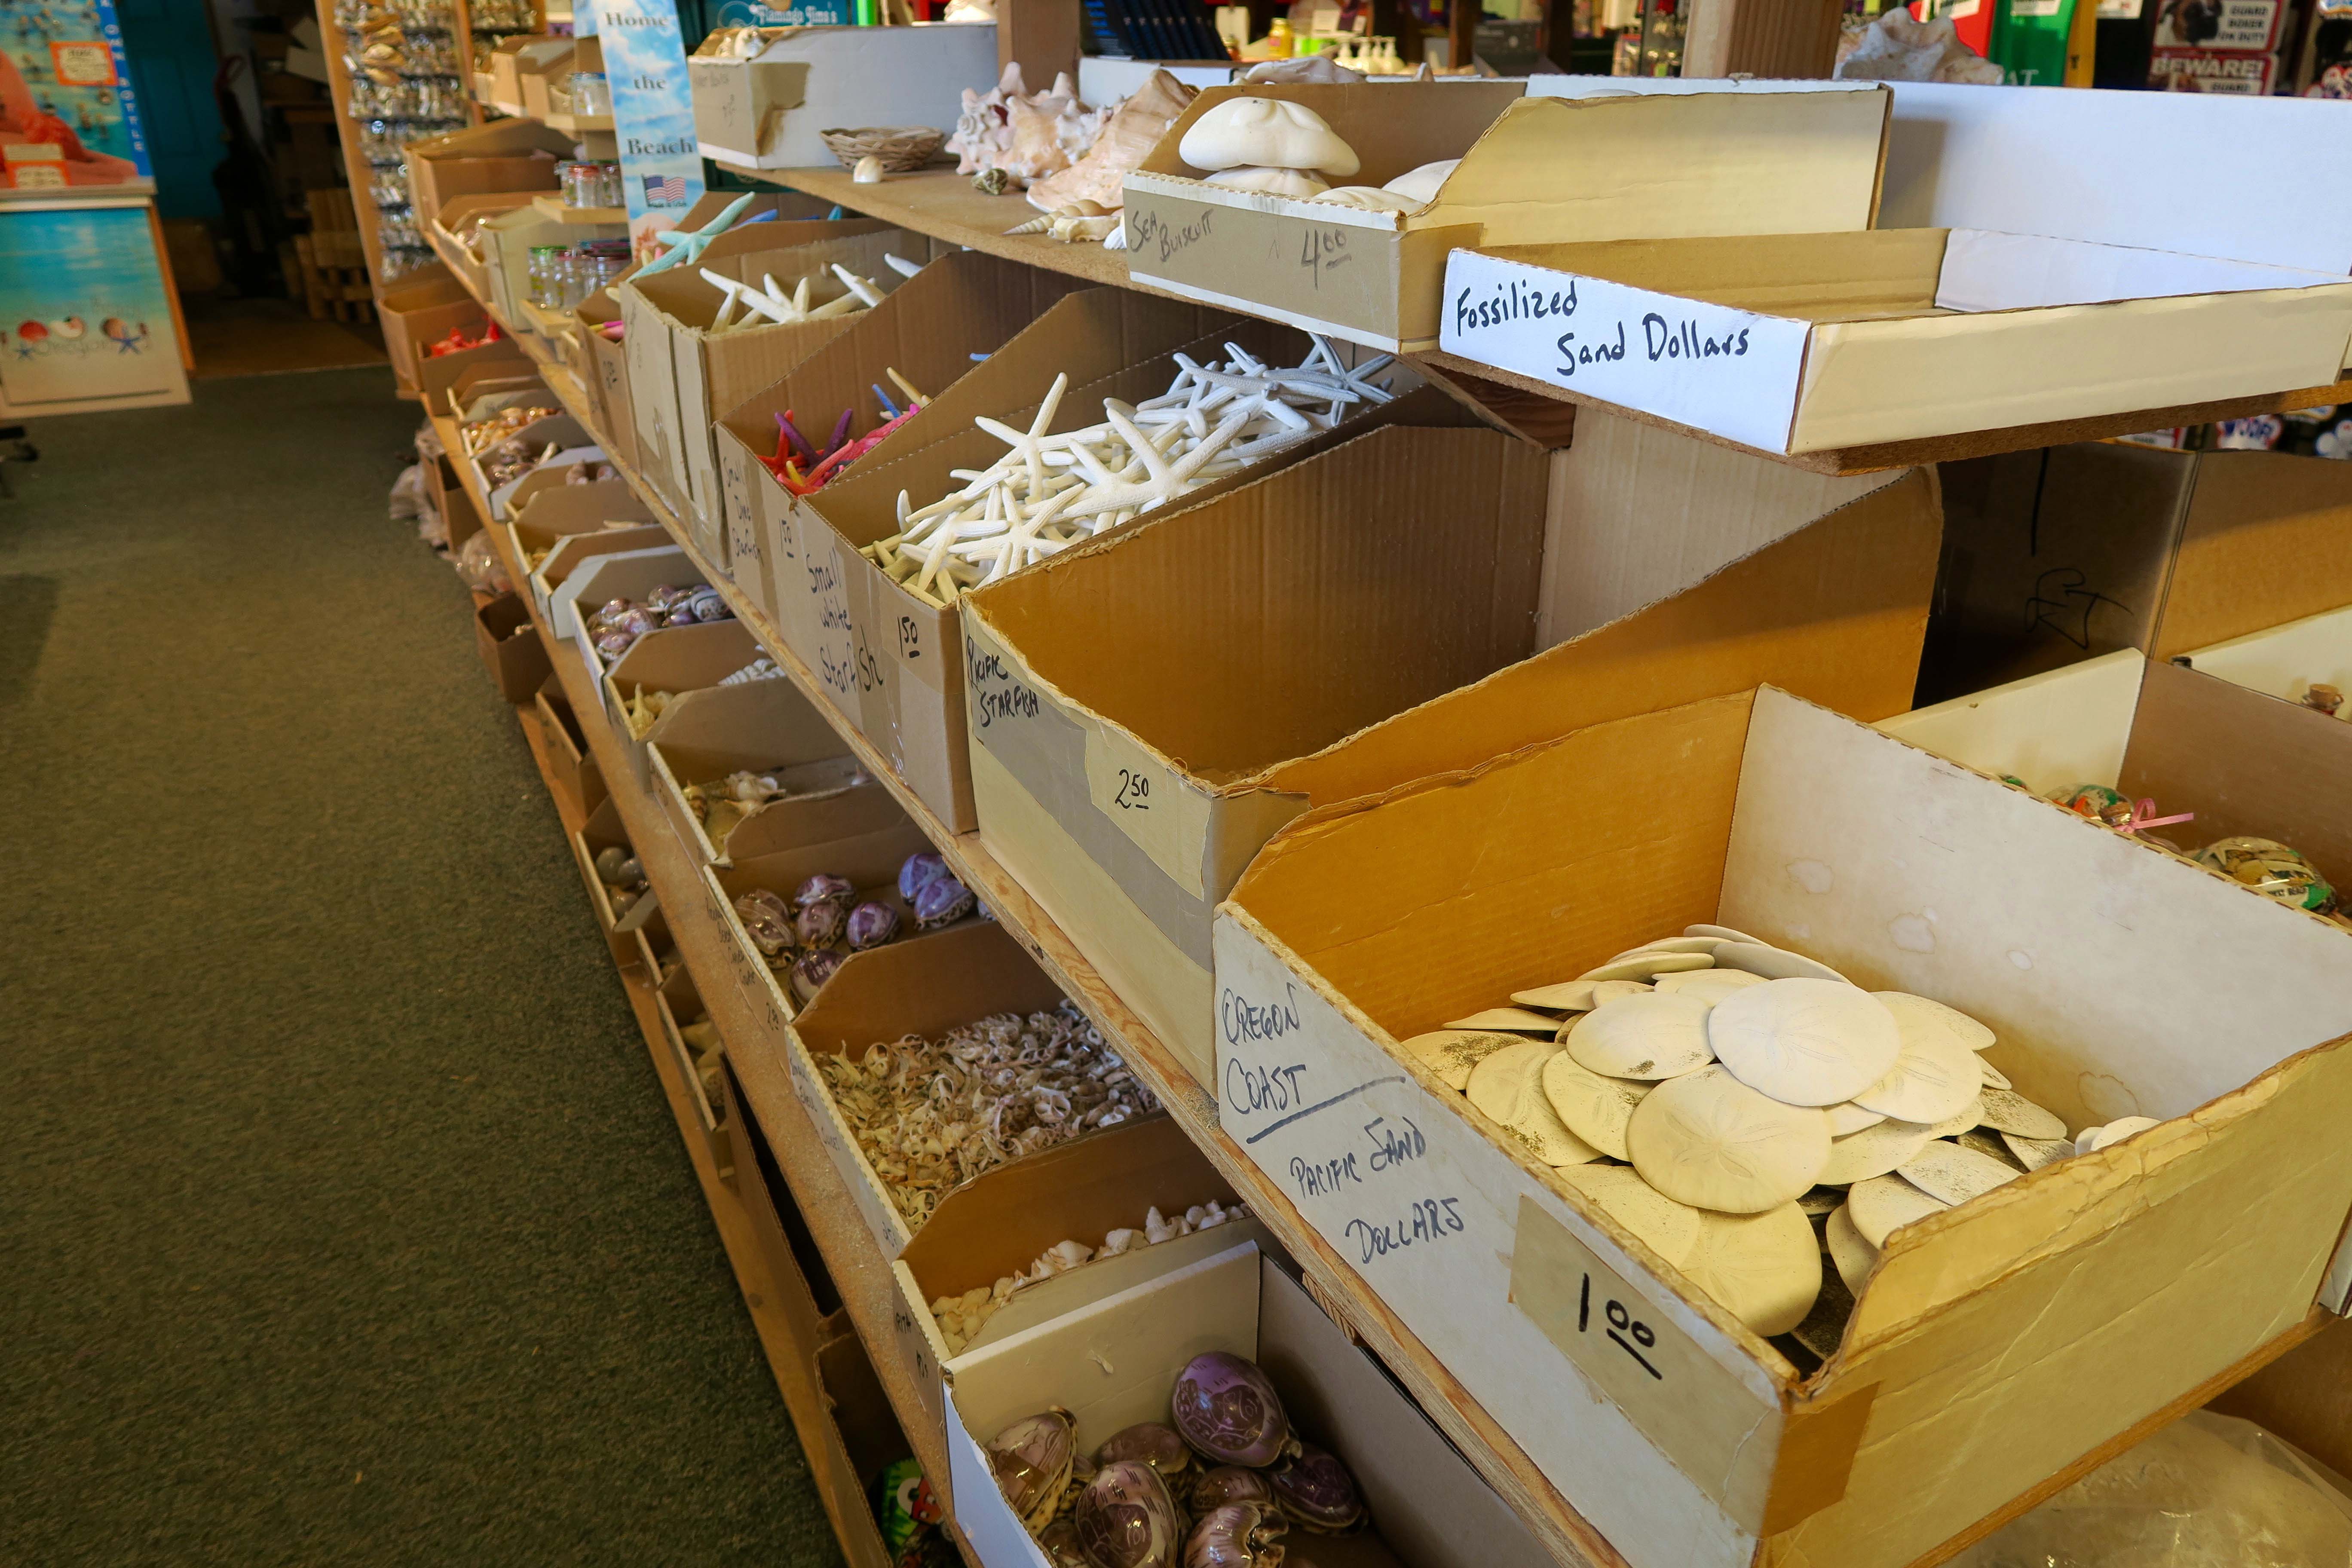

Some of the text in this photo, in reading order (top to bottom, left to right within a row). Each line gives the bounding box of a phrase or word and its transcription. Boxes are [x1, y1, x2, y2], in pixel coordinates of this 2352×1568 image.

[605, 12, 668, 27] Home
[633, 74, 666, 89] the
[2151, 57, 2265, 77] BEWARE!
[627, 136, 693, 155] Beach
[1457, 275, 1577, 337] Fossilized
[1557, 312, 1750, 376] Sand Dollars
[806, 546, 841, 594] Small
[819, 588, 852, 631] white
[820, 623, 884, 693] Starfish
[1115, 769, 1149, 809] 250
[1222, 982, 1301, 1046] OREGON
[1226, 1057, 1307, 1115] COAST
[1290, 1116, 1427, 1199] PACIFIC SAND
[1345, 1197, 1464, 1264] DOLLARS
